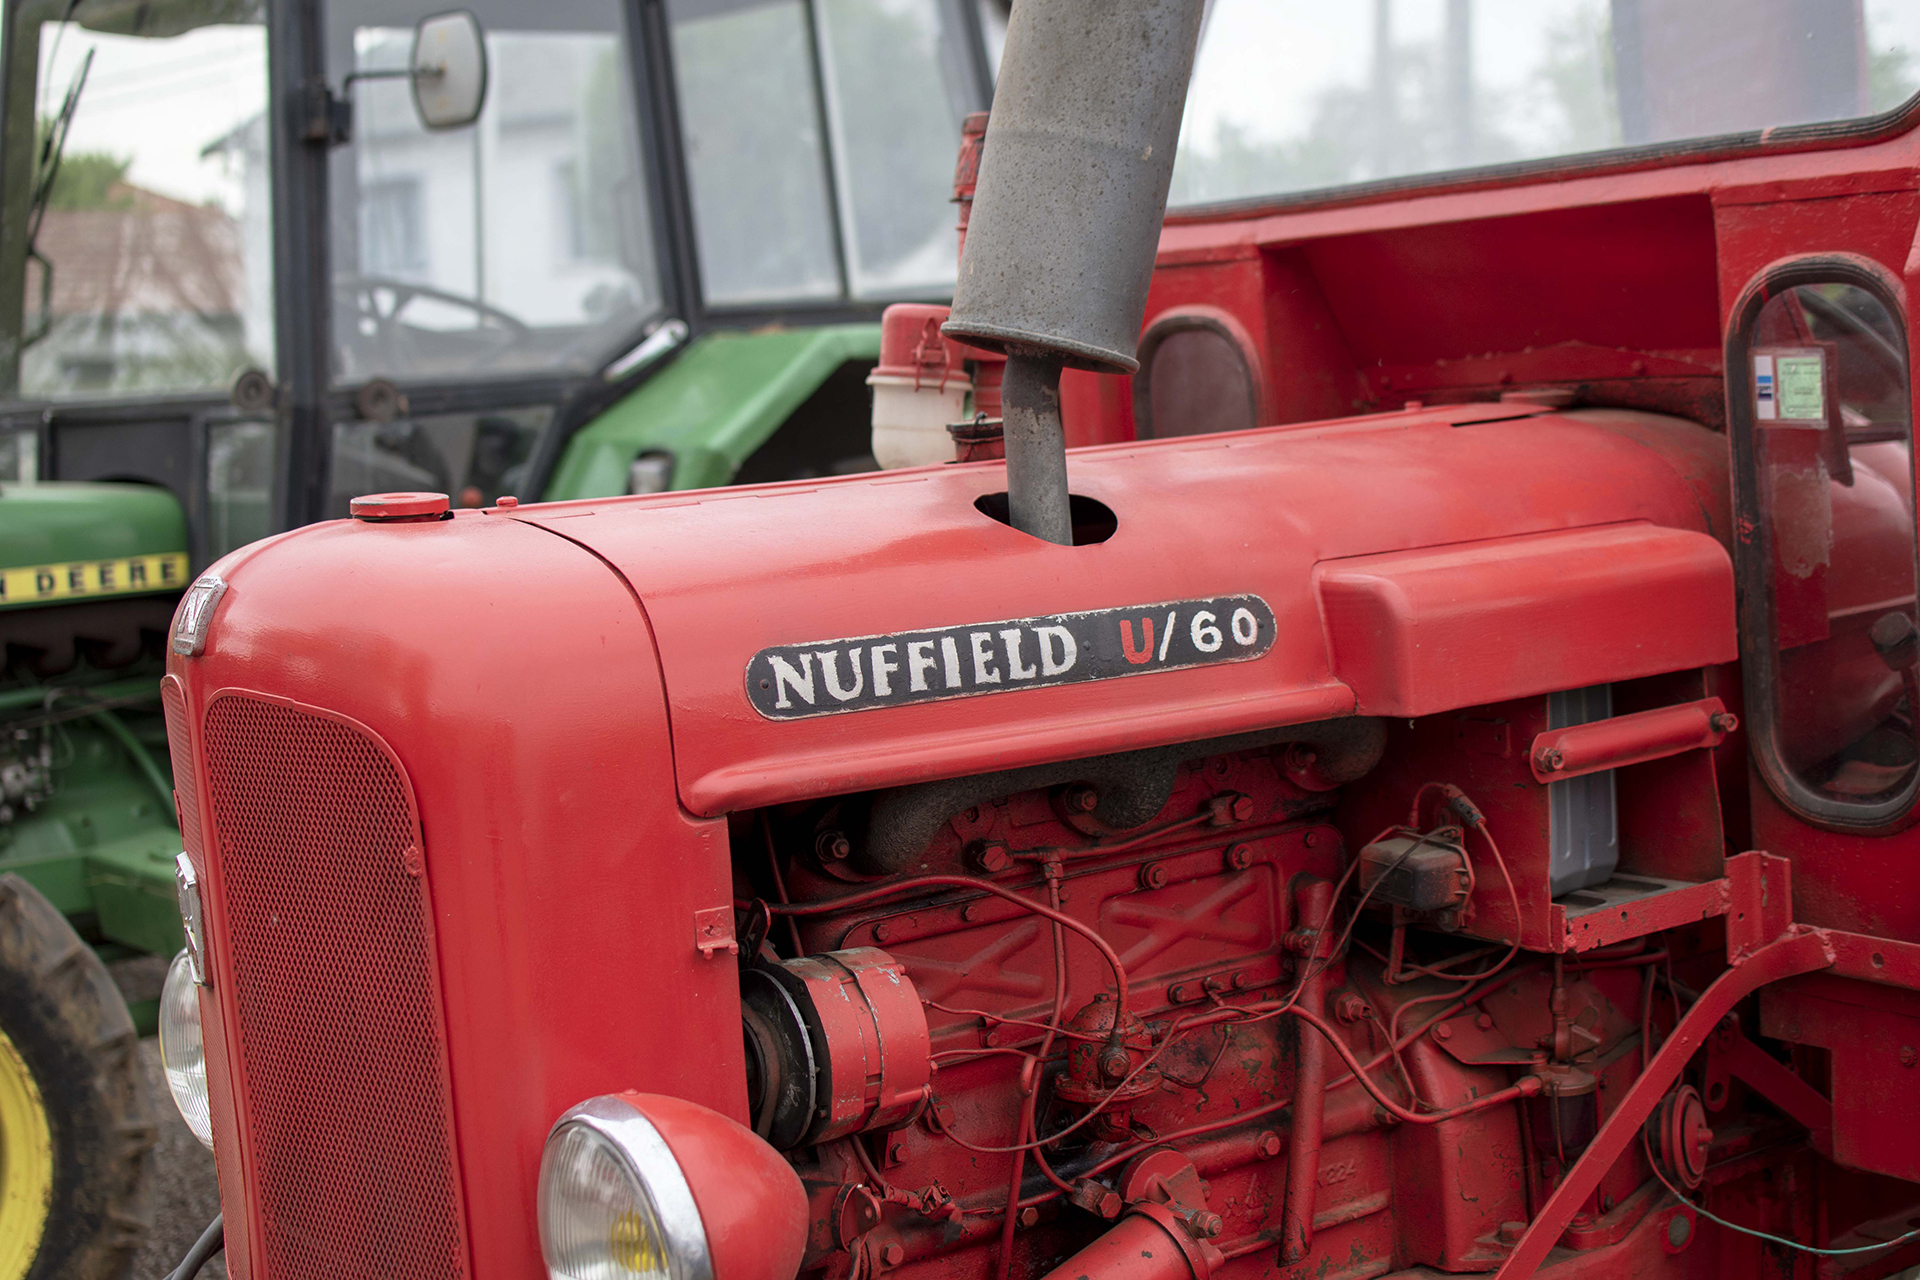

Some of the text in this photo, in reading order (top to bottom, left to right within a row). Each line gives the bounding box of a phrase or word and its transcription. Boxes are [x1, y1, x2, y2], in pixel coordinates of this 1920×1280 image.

[36, 557, 177, 600] DEERE
[767, 608, 1258, 709] NUFFIELD U/60
